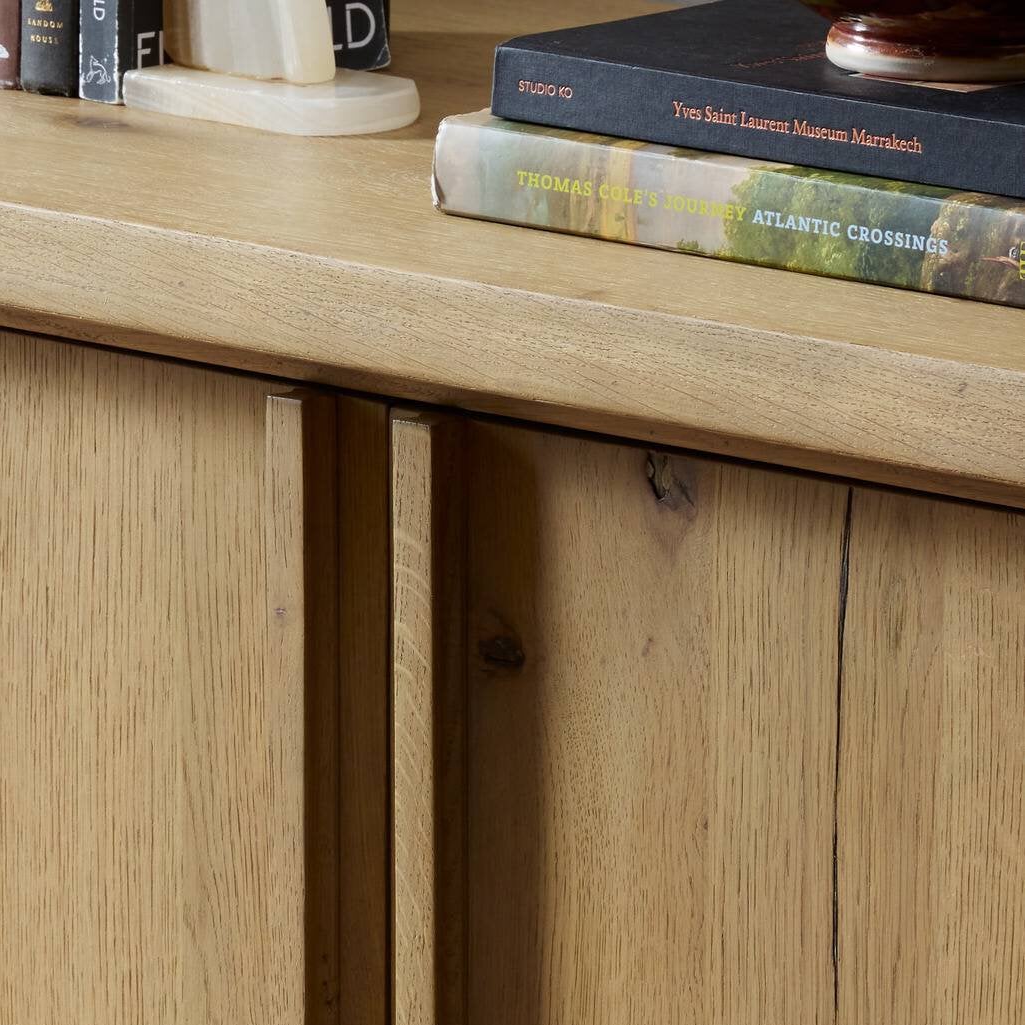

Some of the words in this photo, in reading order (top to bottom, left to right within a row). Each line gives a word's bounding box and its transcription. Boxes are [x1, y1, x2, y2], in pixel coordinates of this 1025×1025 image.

[518, 80, 555, 96] STUDIO
[558, 86, 573, 99] KO
[673, 101, 702, 120] Yves
[705, 106, 737, 126] Saint
[740, 111, 790, 134] Laurent
[793, 119, 848, 144] Museum
[851, 128, 923, 154] Marrakech
[517, 170, 592, 197] THOMAS
[599, 184, 658, 208] COLE'S
[663, 195, 747, 222] JOURNEY
[752, 209, 841, 238] ATLANTIC
[847, 224, 949, 255] CROSSINGS
